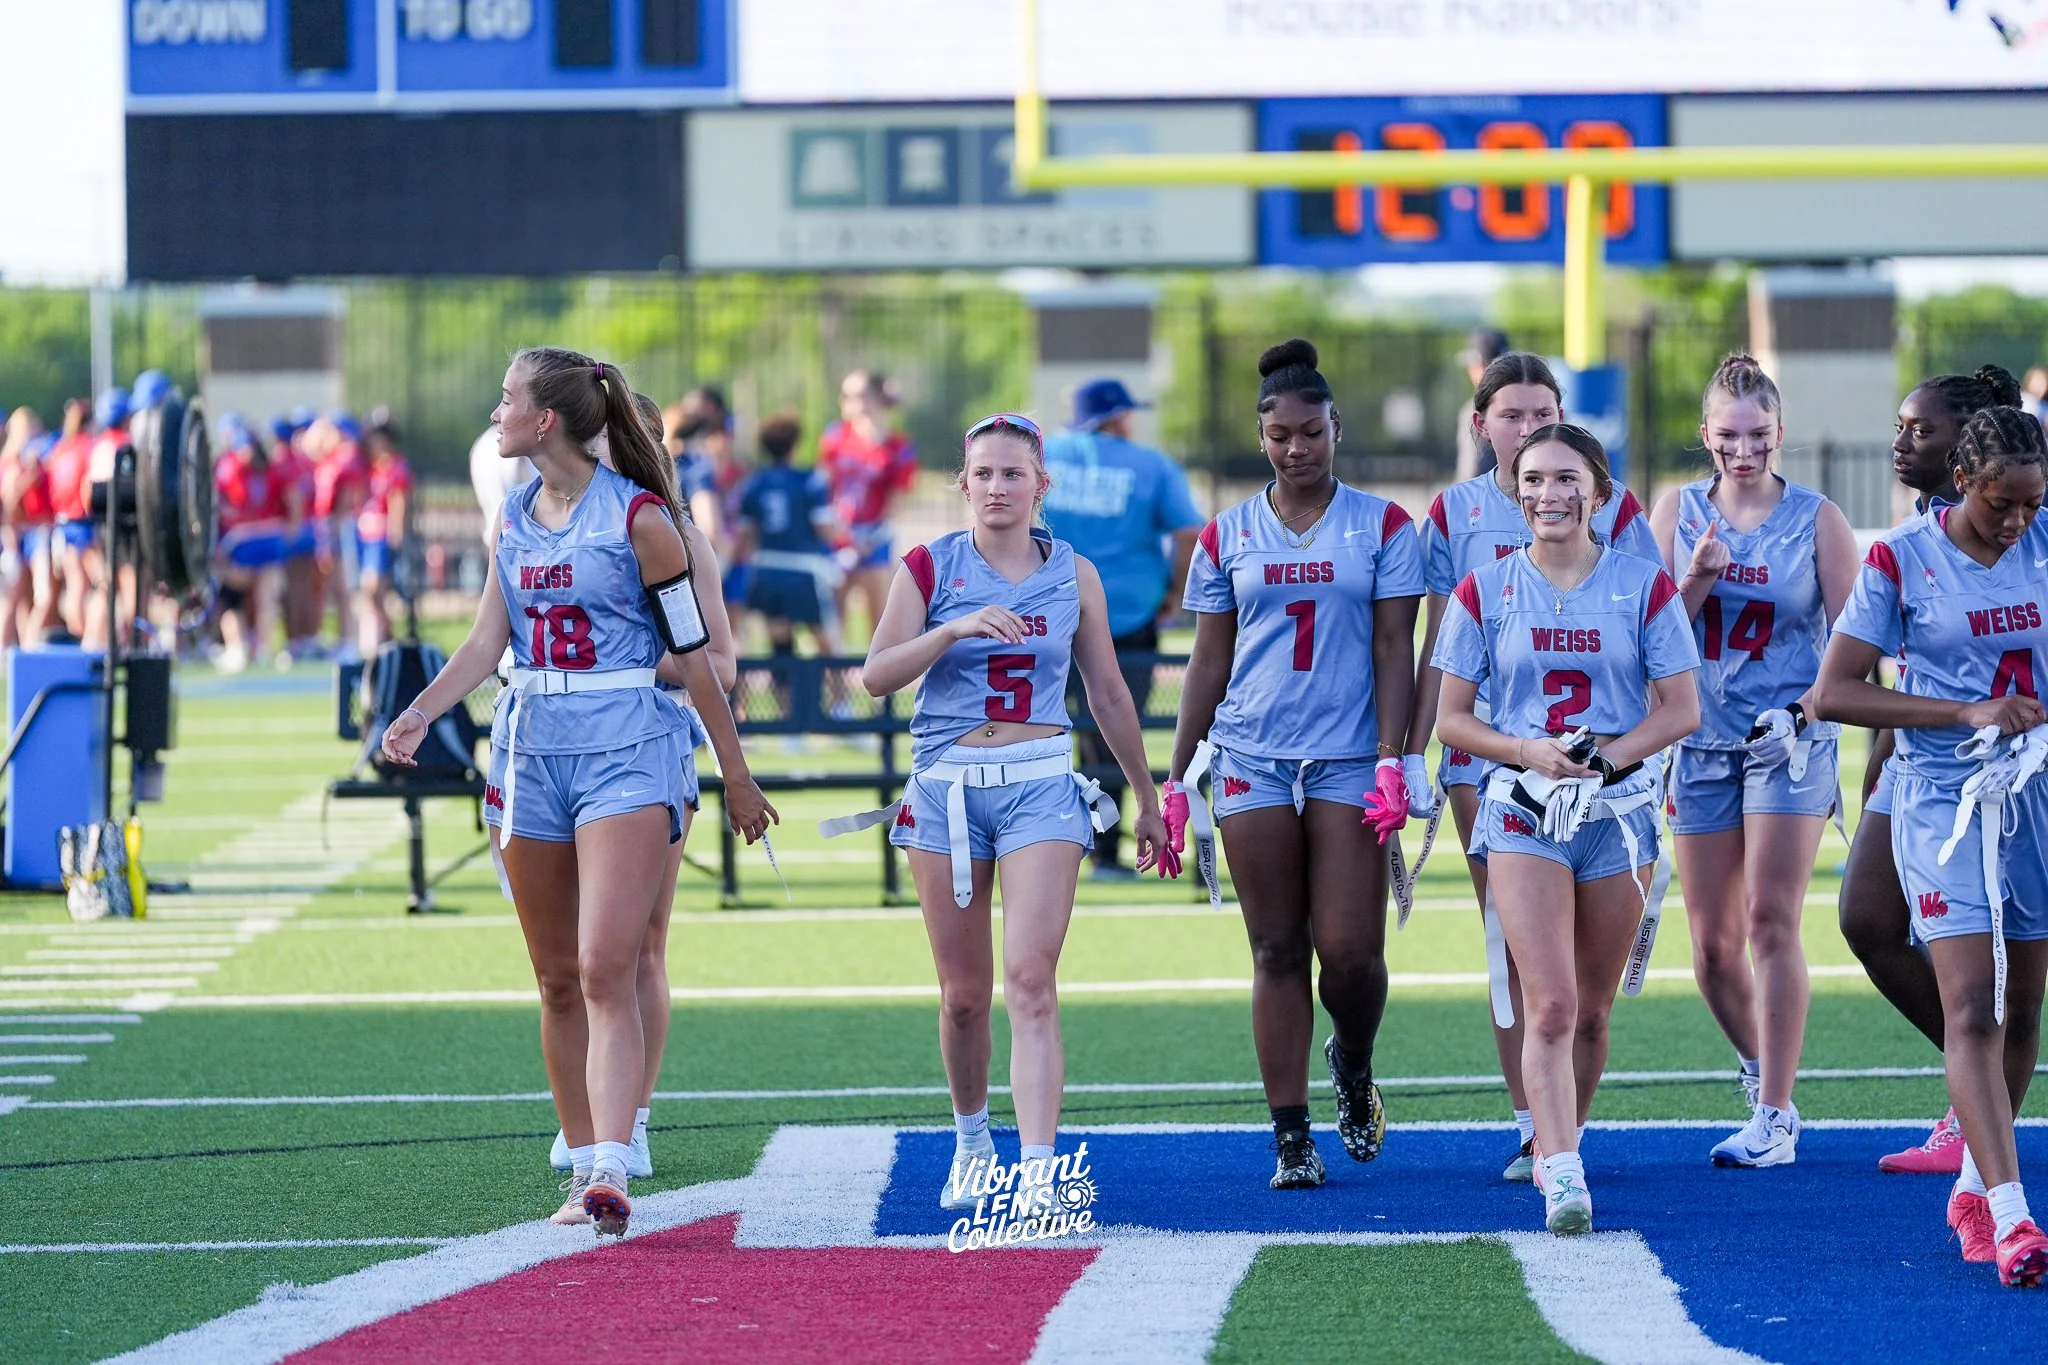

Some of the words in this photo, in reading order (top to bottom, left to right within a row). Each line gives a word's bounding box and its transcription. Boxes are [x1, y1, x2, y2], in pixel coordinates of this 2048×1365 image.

[133, 0, 266, 44] DOWN
[465, 0, 533, 41] GO
[520, 563, 573, 590] WEISS
[1263, 561, 1335, 585] WEISS
[523, 604, 598, 671] 18
[1285, 599, 1317, 672] 1
[1530, 627, 1601, 653] WEISS
[1702, 594, 1775, 662] 14
[1965, 601, 2042, 637] WEISS
[985, 653, 1036, 724] 5
[1989, 647, 2039, 700] 4
[1542, 669, 1592, 735] 2
